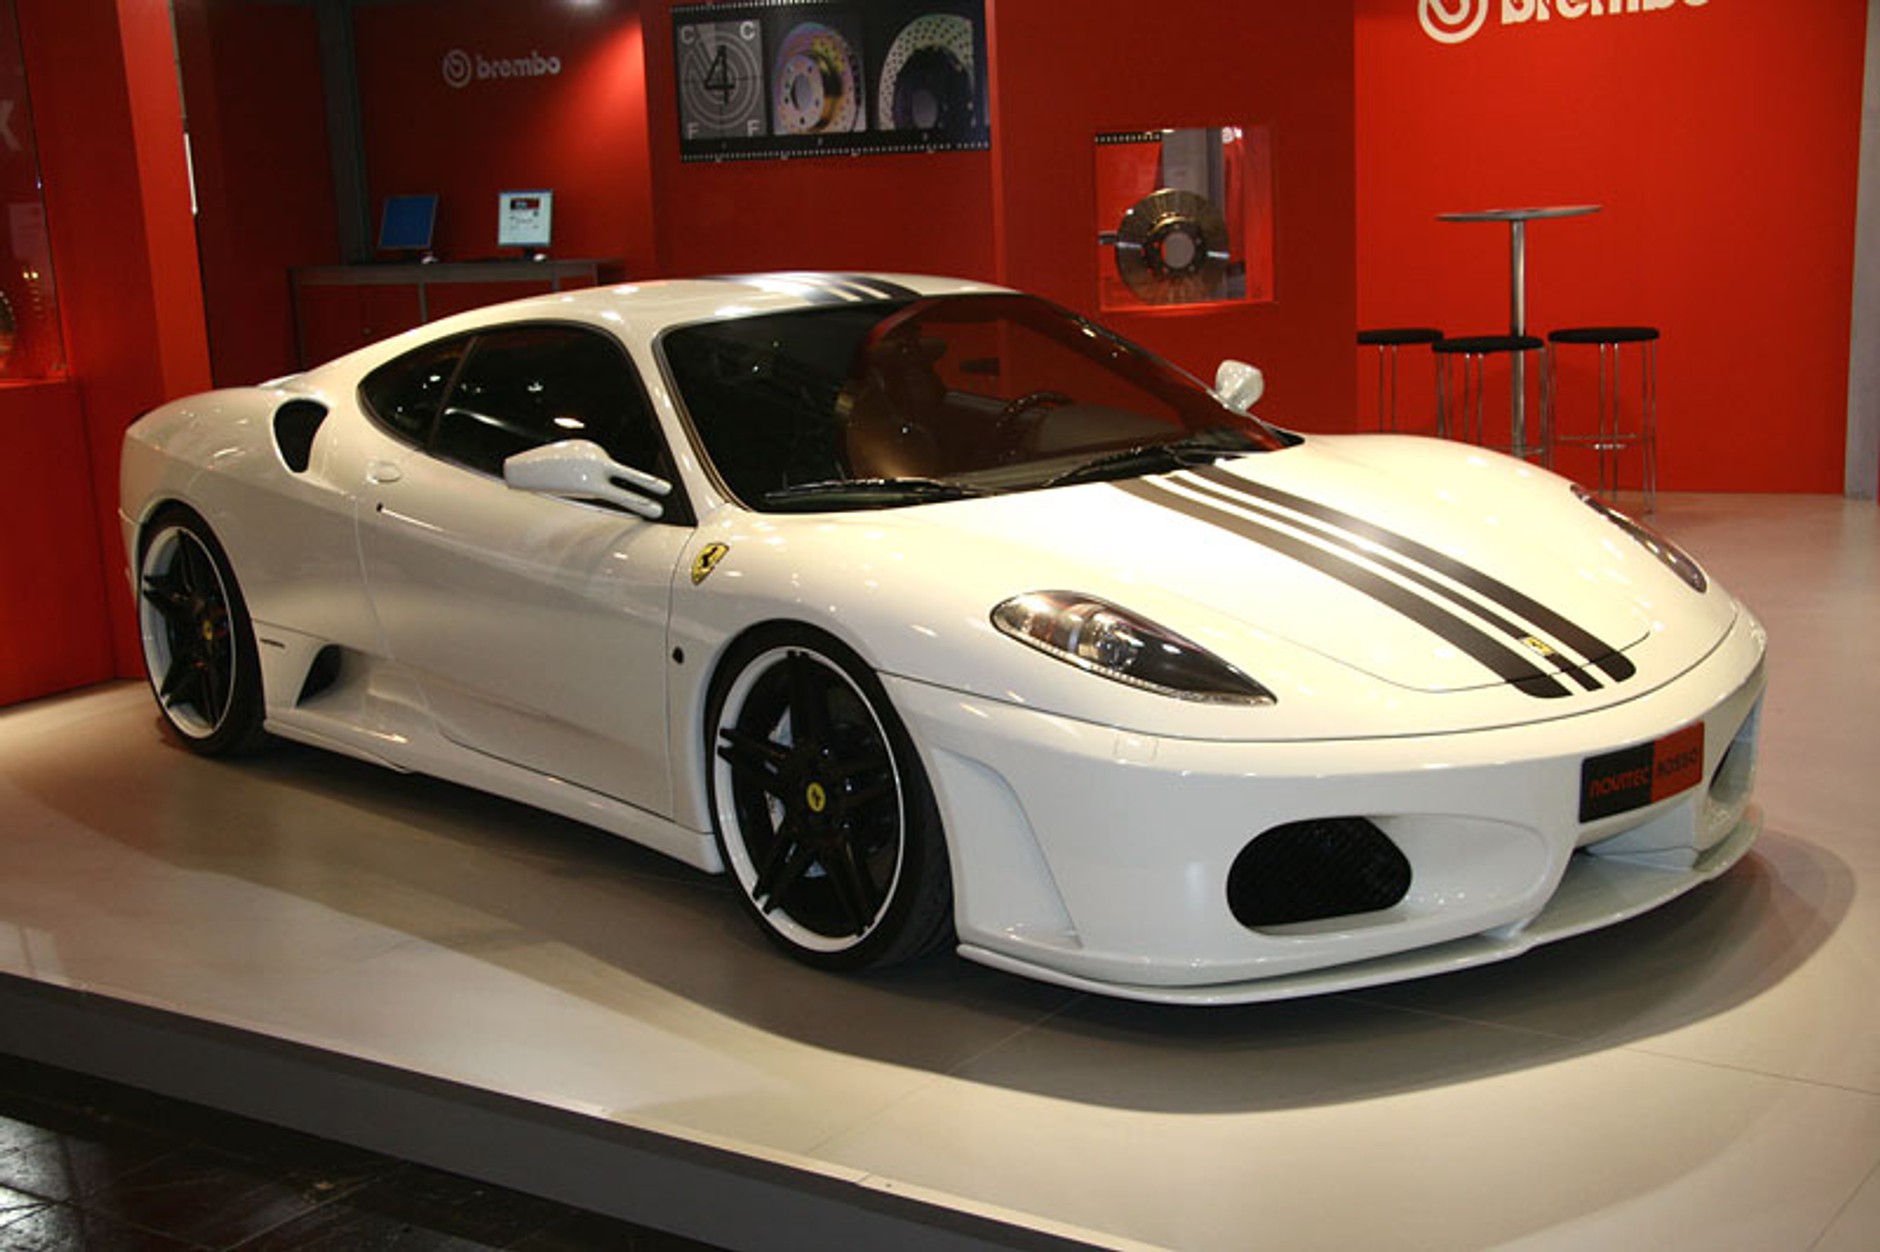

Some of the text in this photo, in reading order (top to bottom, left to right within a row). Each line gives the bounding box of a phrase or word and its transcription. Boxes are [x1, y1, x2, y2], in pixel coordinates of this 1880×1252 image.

[681, 20, 756, 44] C C
[477, 50, 561, 79] brembo
[703, 45, 735, 107] 4
[687, 119, 760, 140] F F
